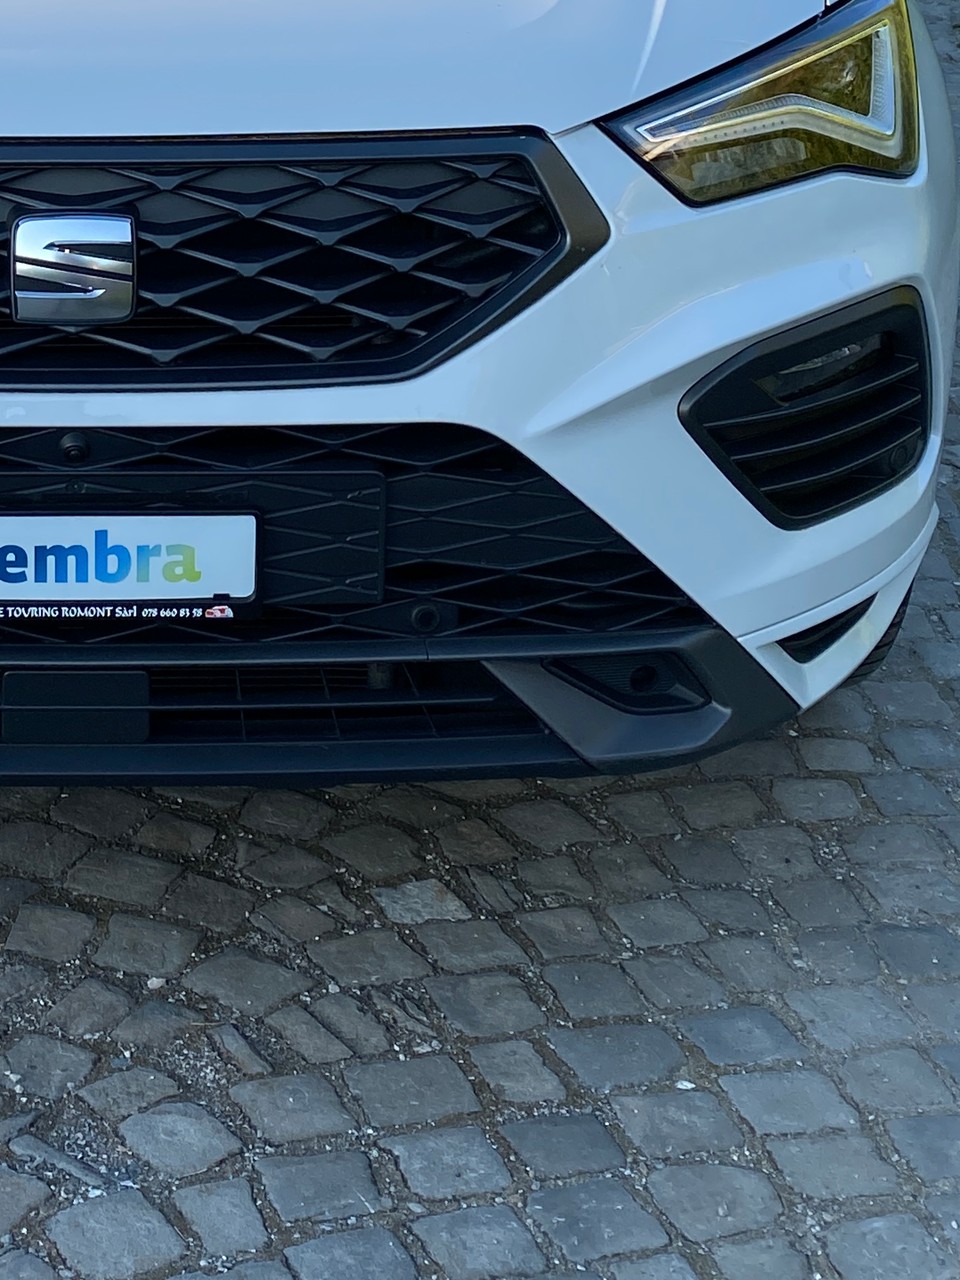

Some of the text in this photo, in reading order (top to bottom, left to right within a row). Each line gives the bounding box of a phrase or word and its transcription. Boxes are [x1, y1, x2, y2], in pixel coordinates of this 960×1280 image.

[6, 606, 59, 618] TOURING
[61, 606, 114, 618] ROMONT
[141, 607, 158, 618] 078
[159, 607, 178, 618] 660
